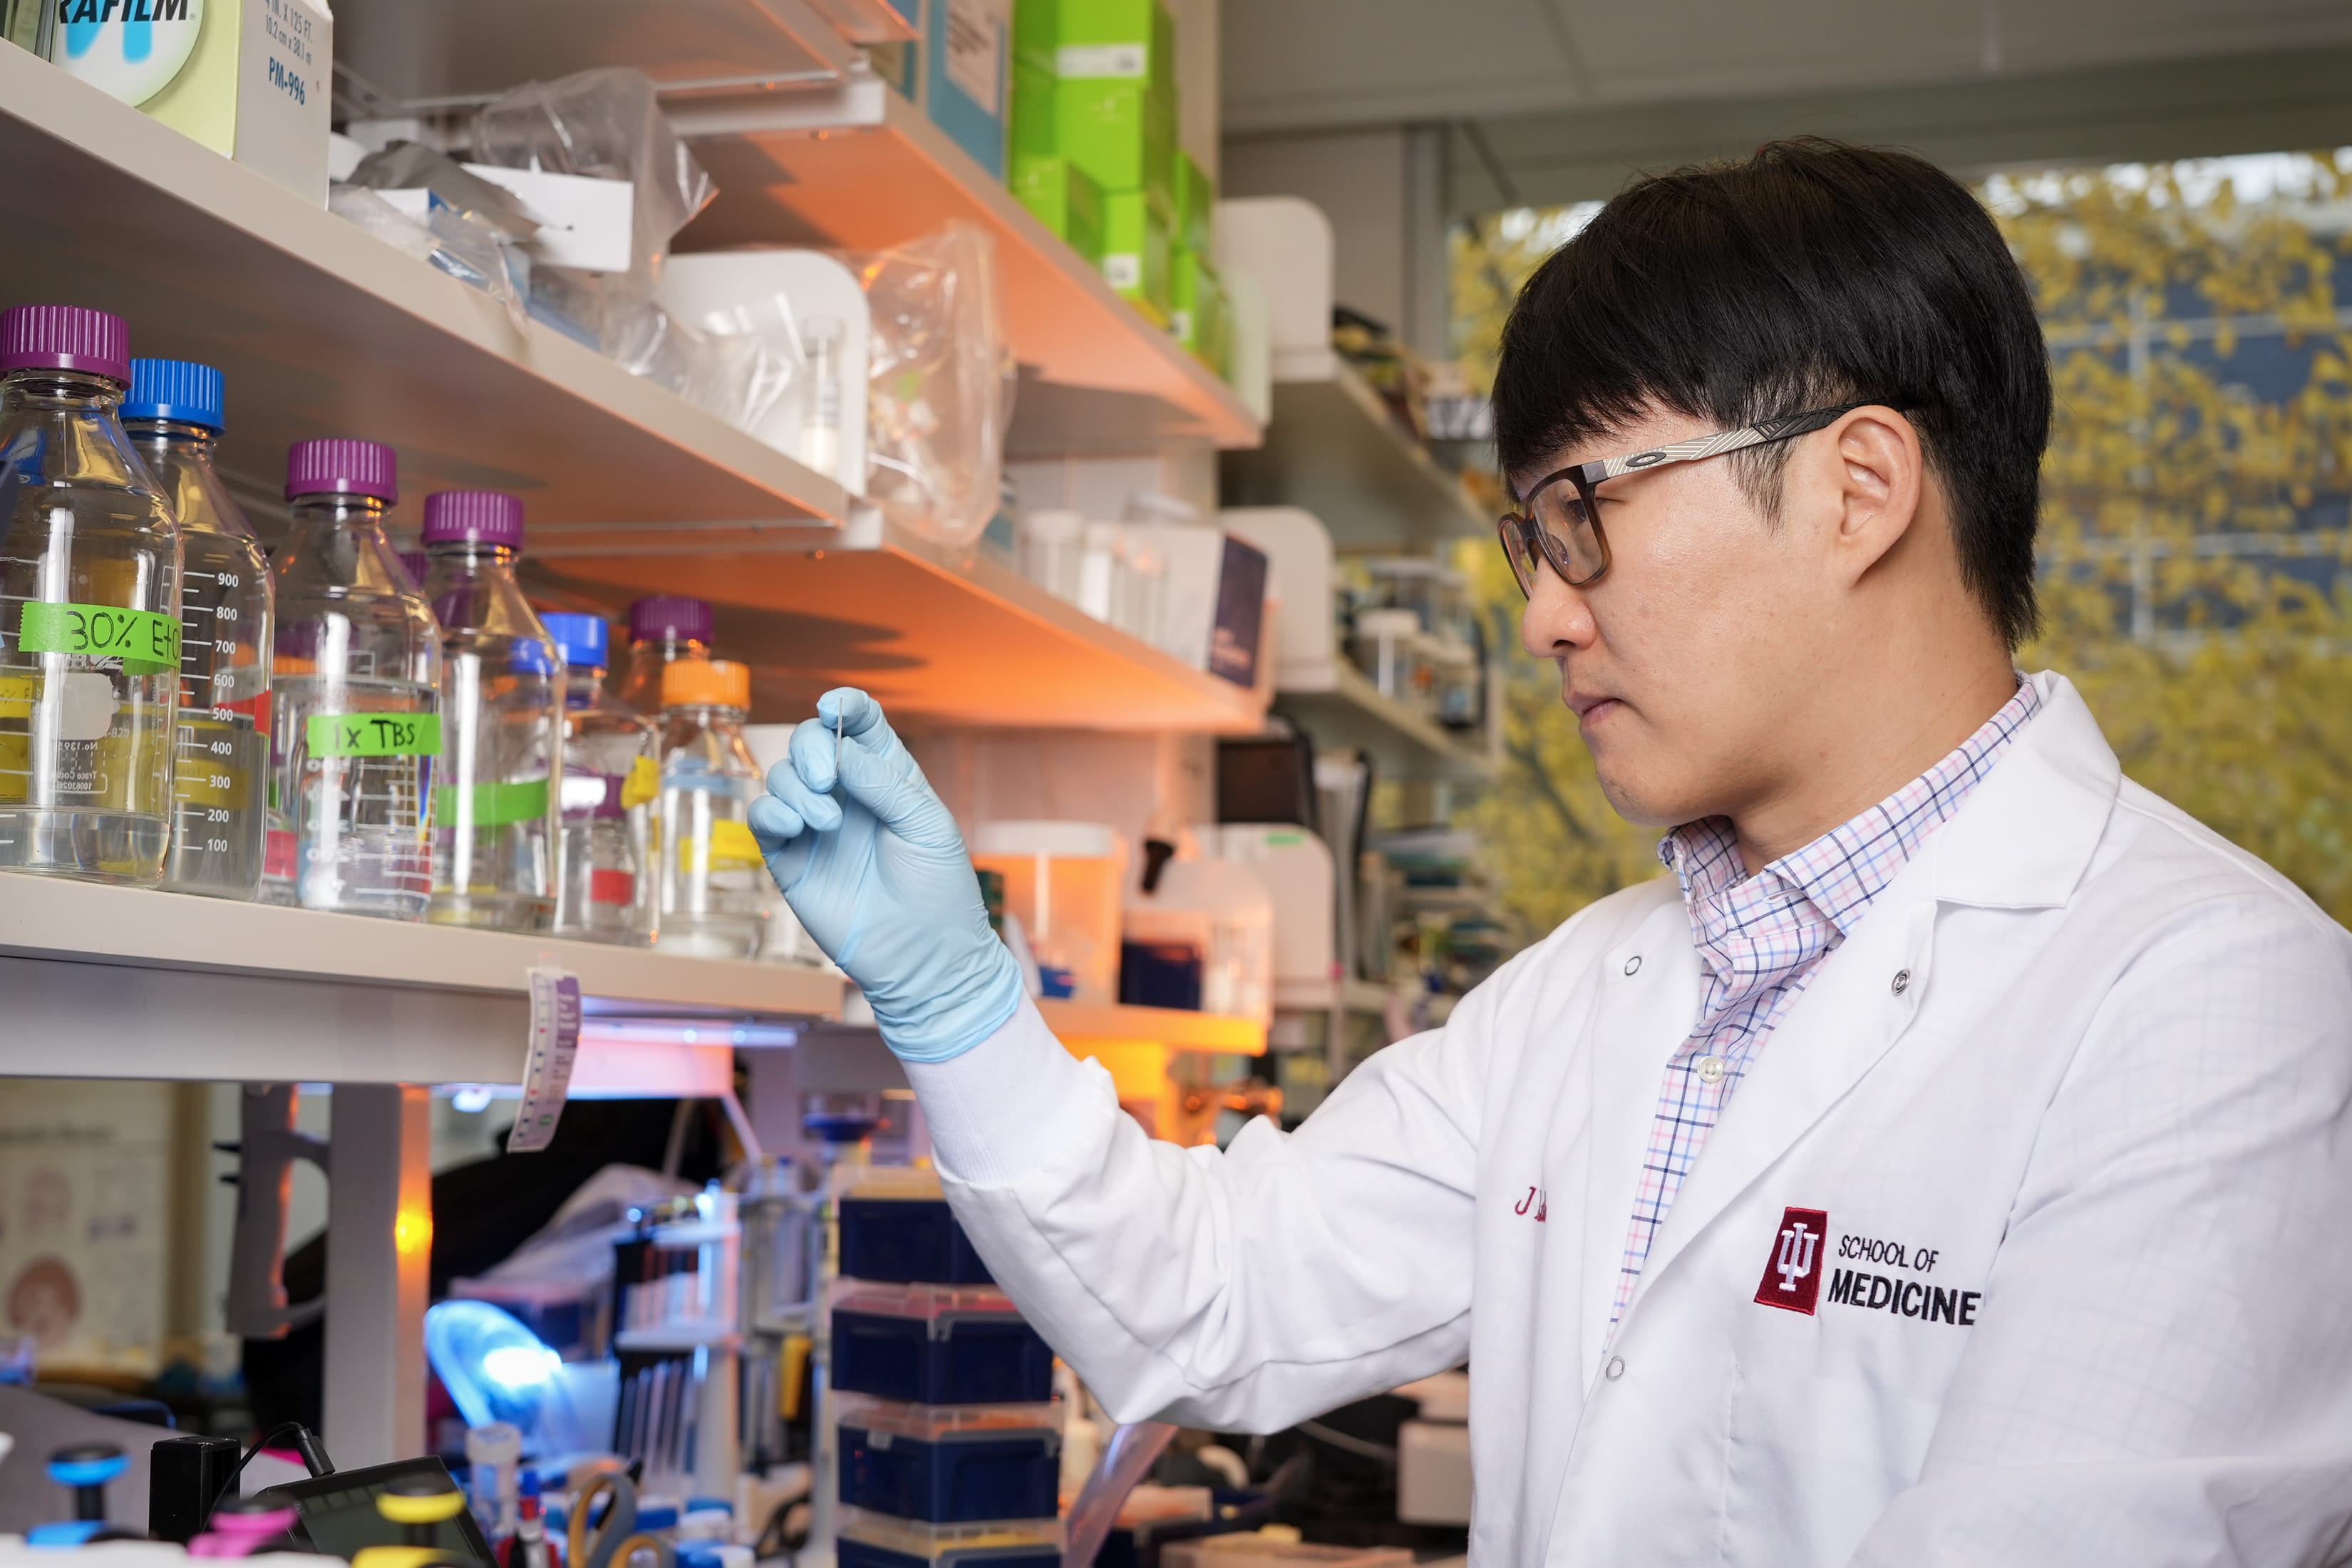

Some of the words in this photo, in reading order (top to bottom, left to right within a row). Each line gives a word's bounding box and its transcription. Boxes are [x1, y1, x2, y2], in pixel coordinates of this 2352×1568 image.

[266, 14, 278, 39] 10.2
[291, 8, 302, 33] 125
[304, 19, 313, 43] FT.
[269, 56, 305, 105] PM-996
[218, 572, 239, 587] 900
[217, 606, 237, 621] 800
[66, 611, 138, 650] 30%
[153, 619, 181, 661] EtO
[215, 639, 236, 654] 700
[214, 674, 234, 688] 600
[212, 707, 234, 722] 500
[370, 719, 416, 749] TBS
[211, 741, 232, 755] 400
[210, 775, 230, 790] 300
[207, 809, 229, 823] 200
[207, 838, 227, 852] 100
[1839, 1234, 1908, 1267] SCHOOL
[1914, 1248, 1939, 1272] OF
[1827, 1269, 1981, 1326] MEDICINE
